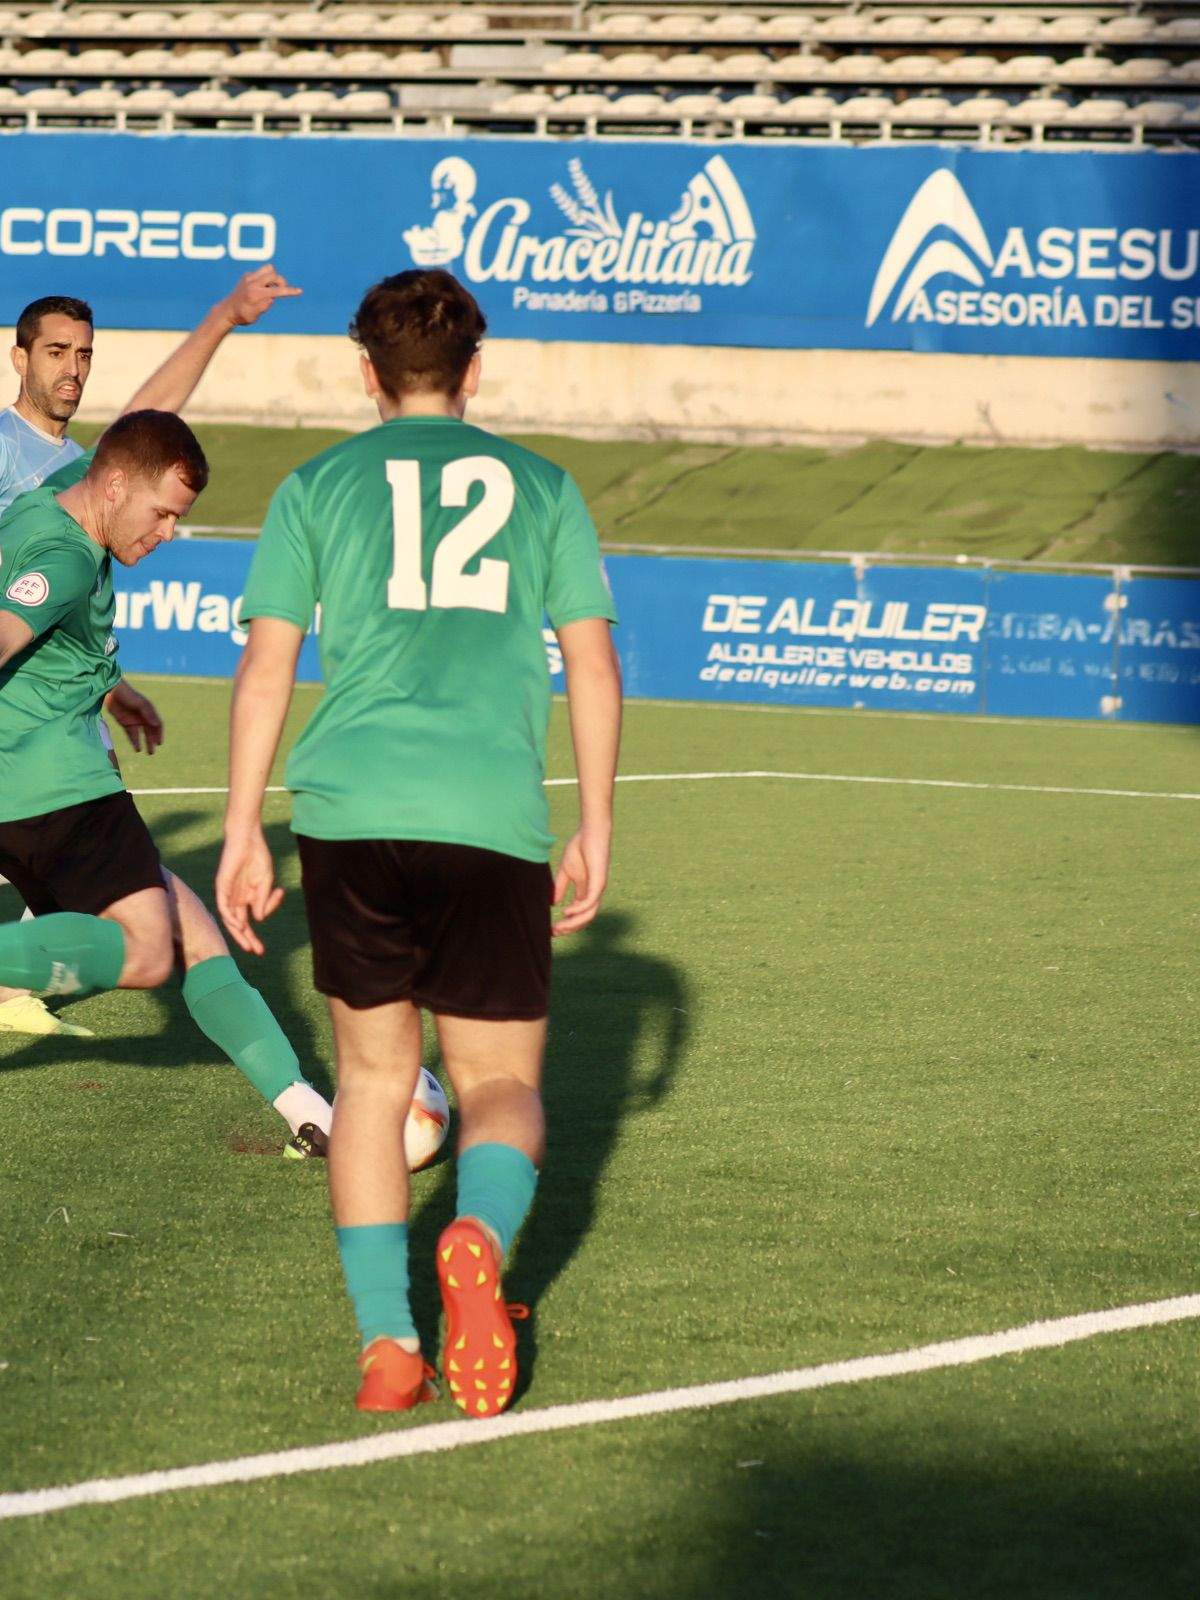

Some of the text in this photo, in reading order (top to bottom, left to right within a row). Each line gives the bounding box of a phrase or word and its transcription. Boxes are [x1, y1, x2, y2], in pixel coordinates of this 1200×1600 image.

[0, 207, 276, 261] CORECO
[990, 226, 1200, 281] ASESU
[907, 286, 1200, 330] ASESORÍA DEL S
[385, 455, 516, 614] 12
[702, 594, 988, 642] DE ALQUILER
[706, 642, 814, 666] ALQUILER
[815, 646, 847, 668] DE
